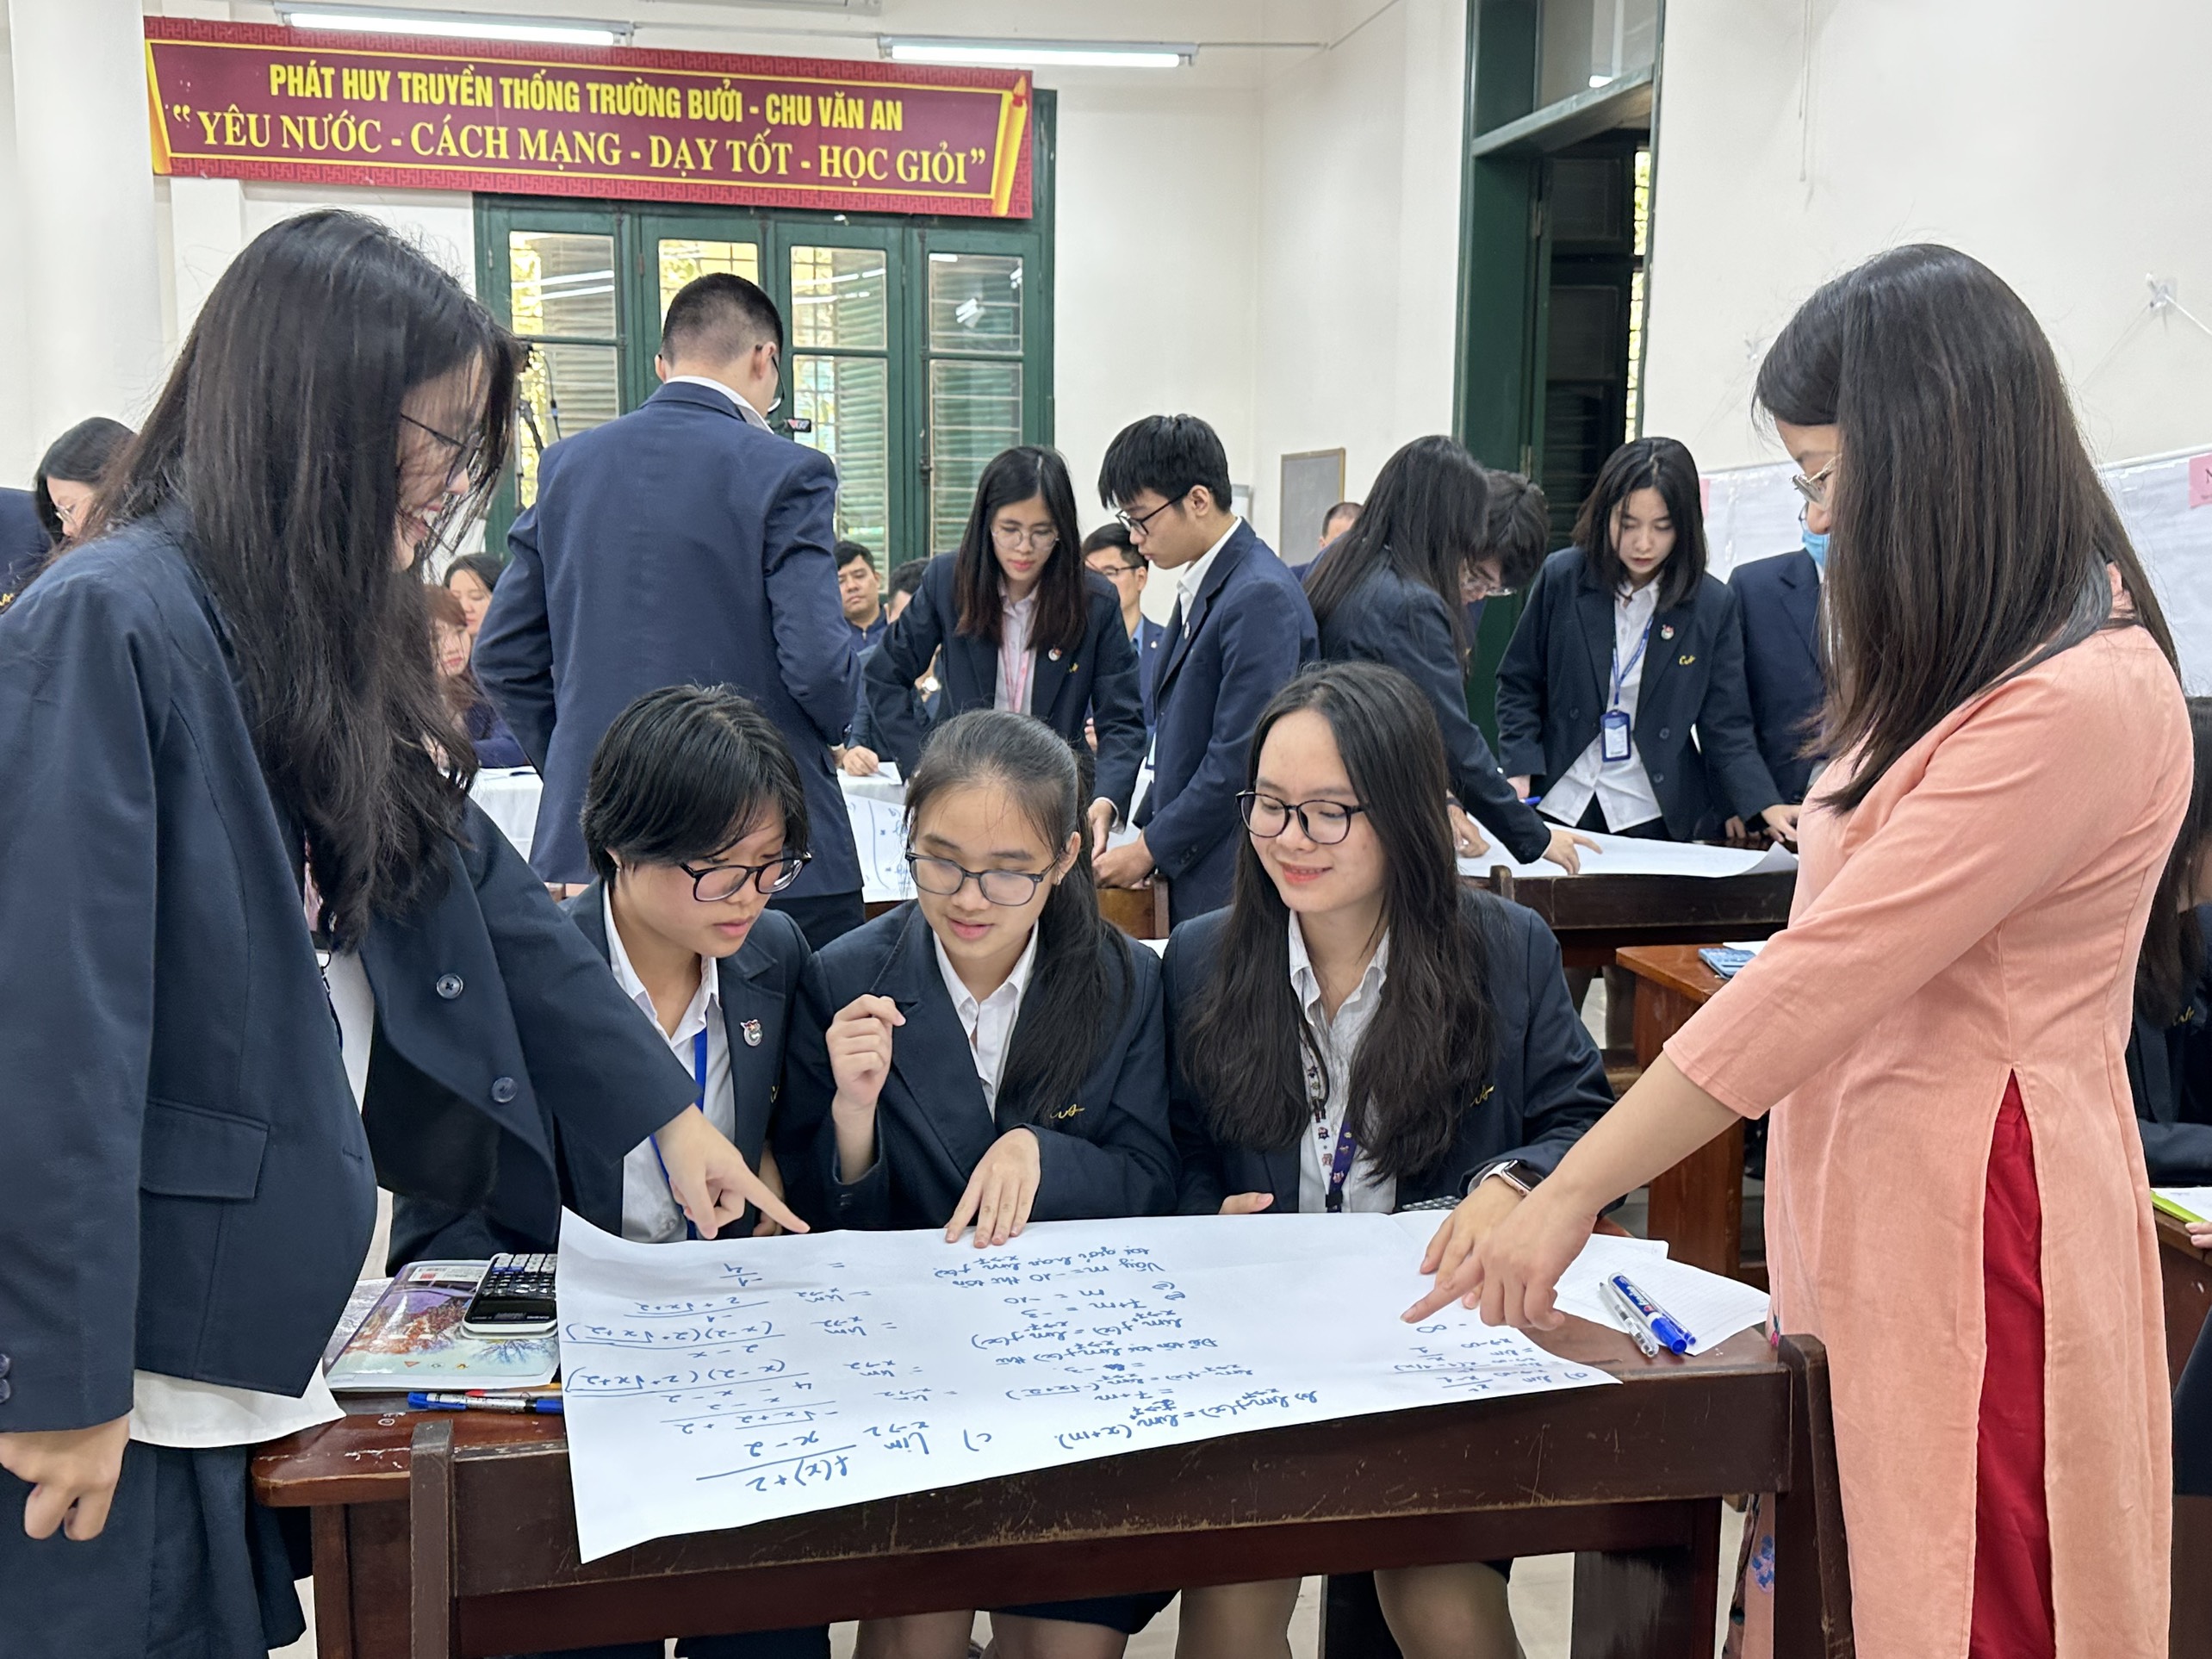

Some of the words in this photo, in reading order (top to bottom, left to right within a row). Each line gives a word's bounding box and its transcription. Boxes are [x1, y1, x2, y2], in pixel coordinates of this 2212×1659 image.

[270, 60, 334, 98] PHÁT
[343, 69, 390, 102] HUY
[398, 64, 493, 107] TRUYỀN
[500, 68, 580, 112] THỐNG
[587, 78, 680, 118] TRƯỜNG
[688, 78, 743, 122] BƯỞI
[749, 105, 759, 114] -
[766, 93, 811, 127] CHU
[818, 91, 865, 130] VĂN
[870, 100, 903, 132] AN
[282, 110, 382, 153] NƯỚC
[410, 115, 507, 159] CÁCH
[518, 128, 621, 171] MẠNG
[649, 135, 717, 177] DẠY
[726, 129, 792, 175] TỐT
[819, 146, 888, 186] HỌC
